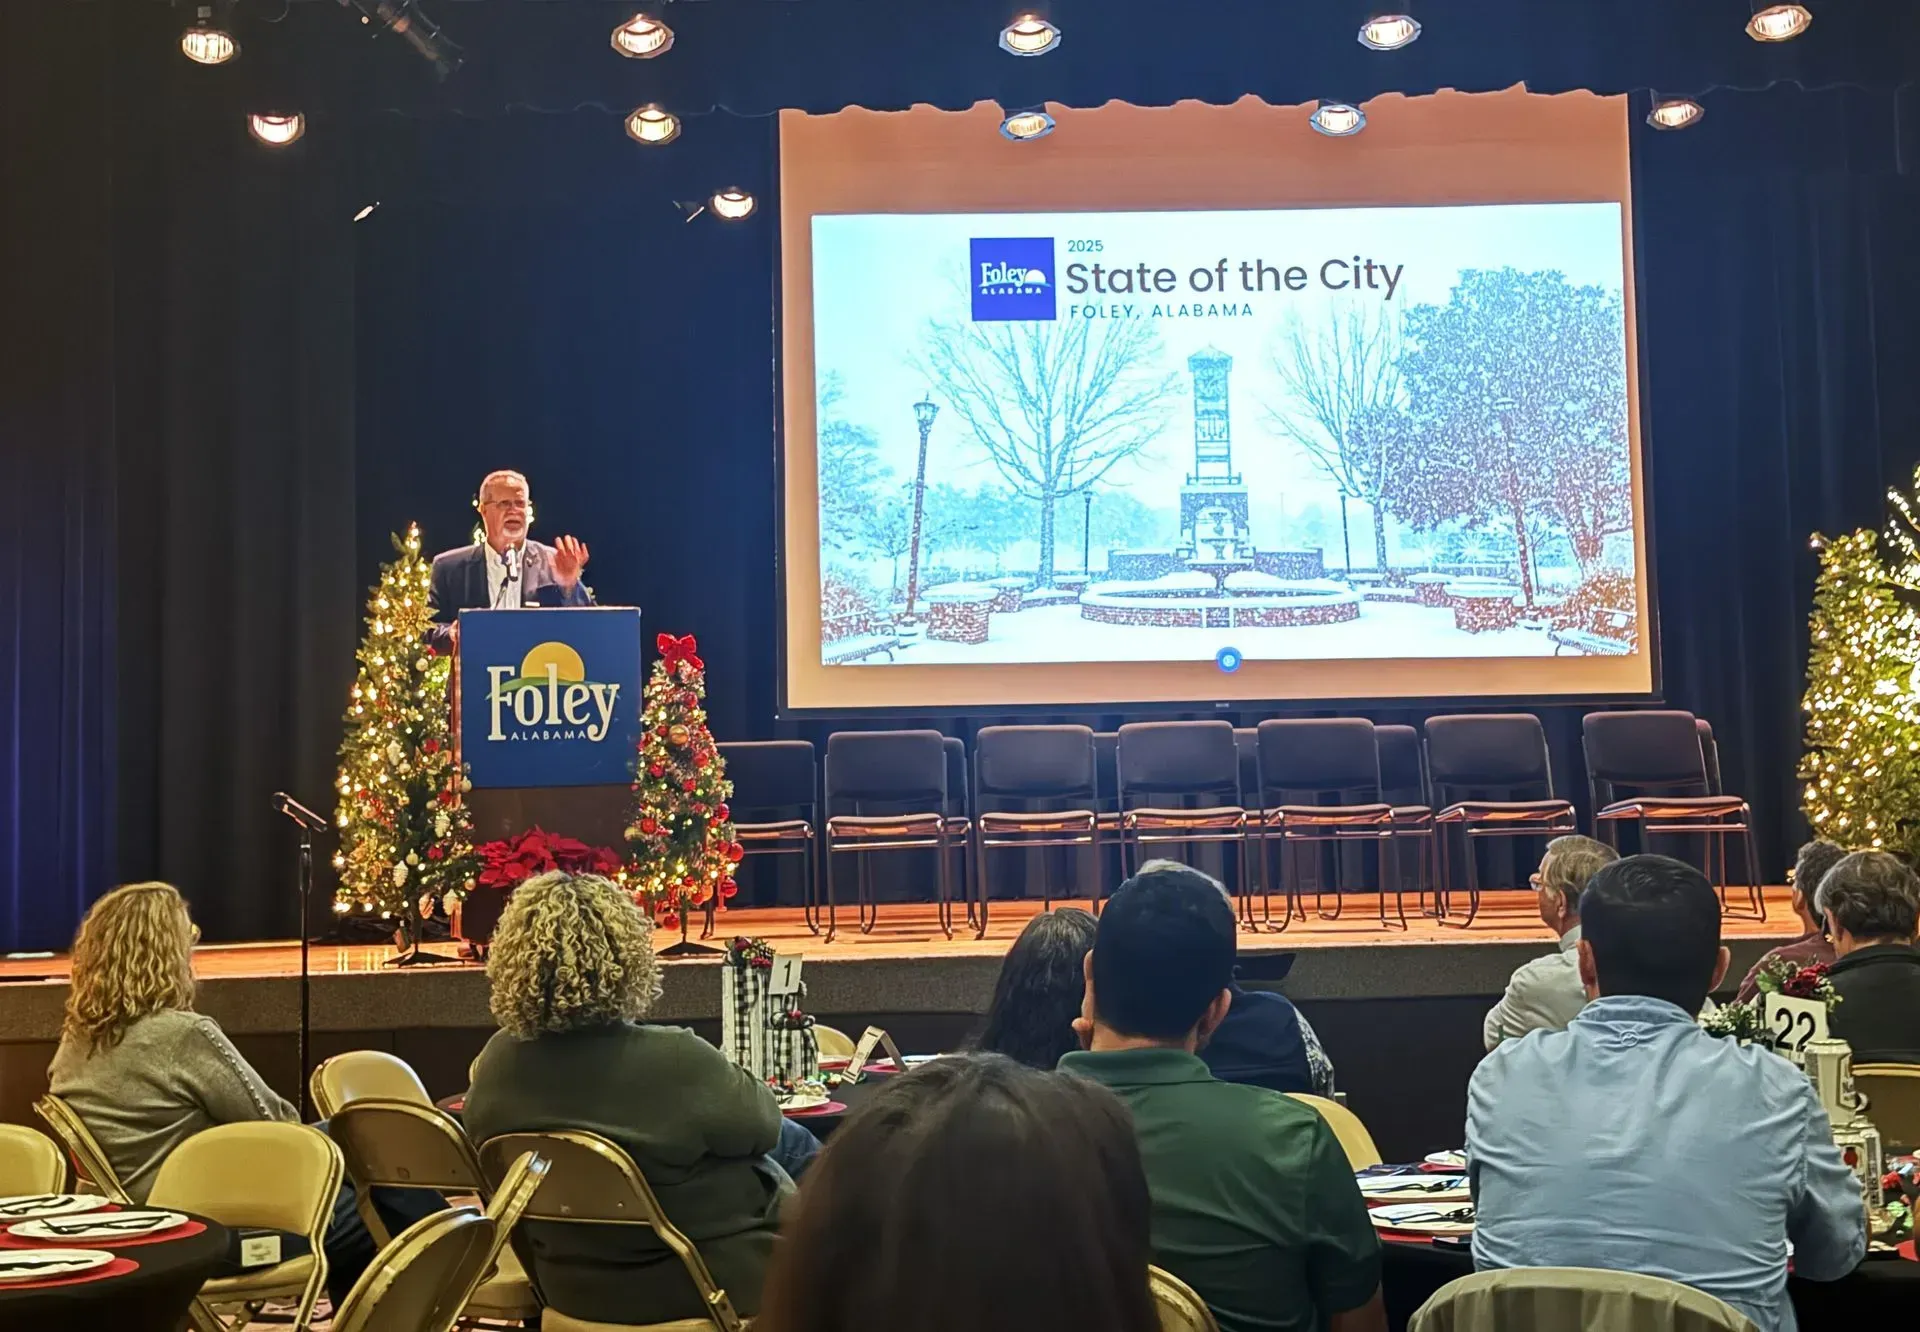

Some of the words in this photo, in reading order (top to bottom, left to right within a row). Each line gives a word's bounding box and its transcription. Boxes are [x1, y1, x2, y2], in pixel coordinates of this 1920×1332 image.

[1067, 239, 1104, 252] 2025
[980, 261, 1027, 287] Foley
[1066, 262, 1177, 294] State
[1189, 258, 1228, 292] of
[1239, 258, 1307, 292] the
[1320, 255, 1404, 301] City
[981, 287, 1042, 295] ALABAMA
[1070, 304, 1142, 320] FOLEY,
[1151, 303, 1254, 318] ALABAMA
[486, 663, 621, 742] Foley
[511, 730, 587, 741] ALABAMA
[784, 960, 792, 987] 1
[1775, 1007, 1816, 1052] 22
